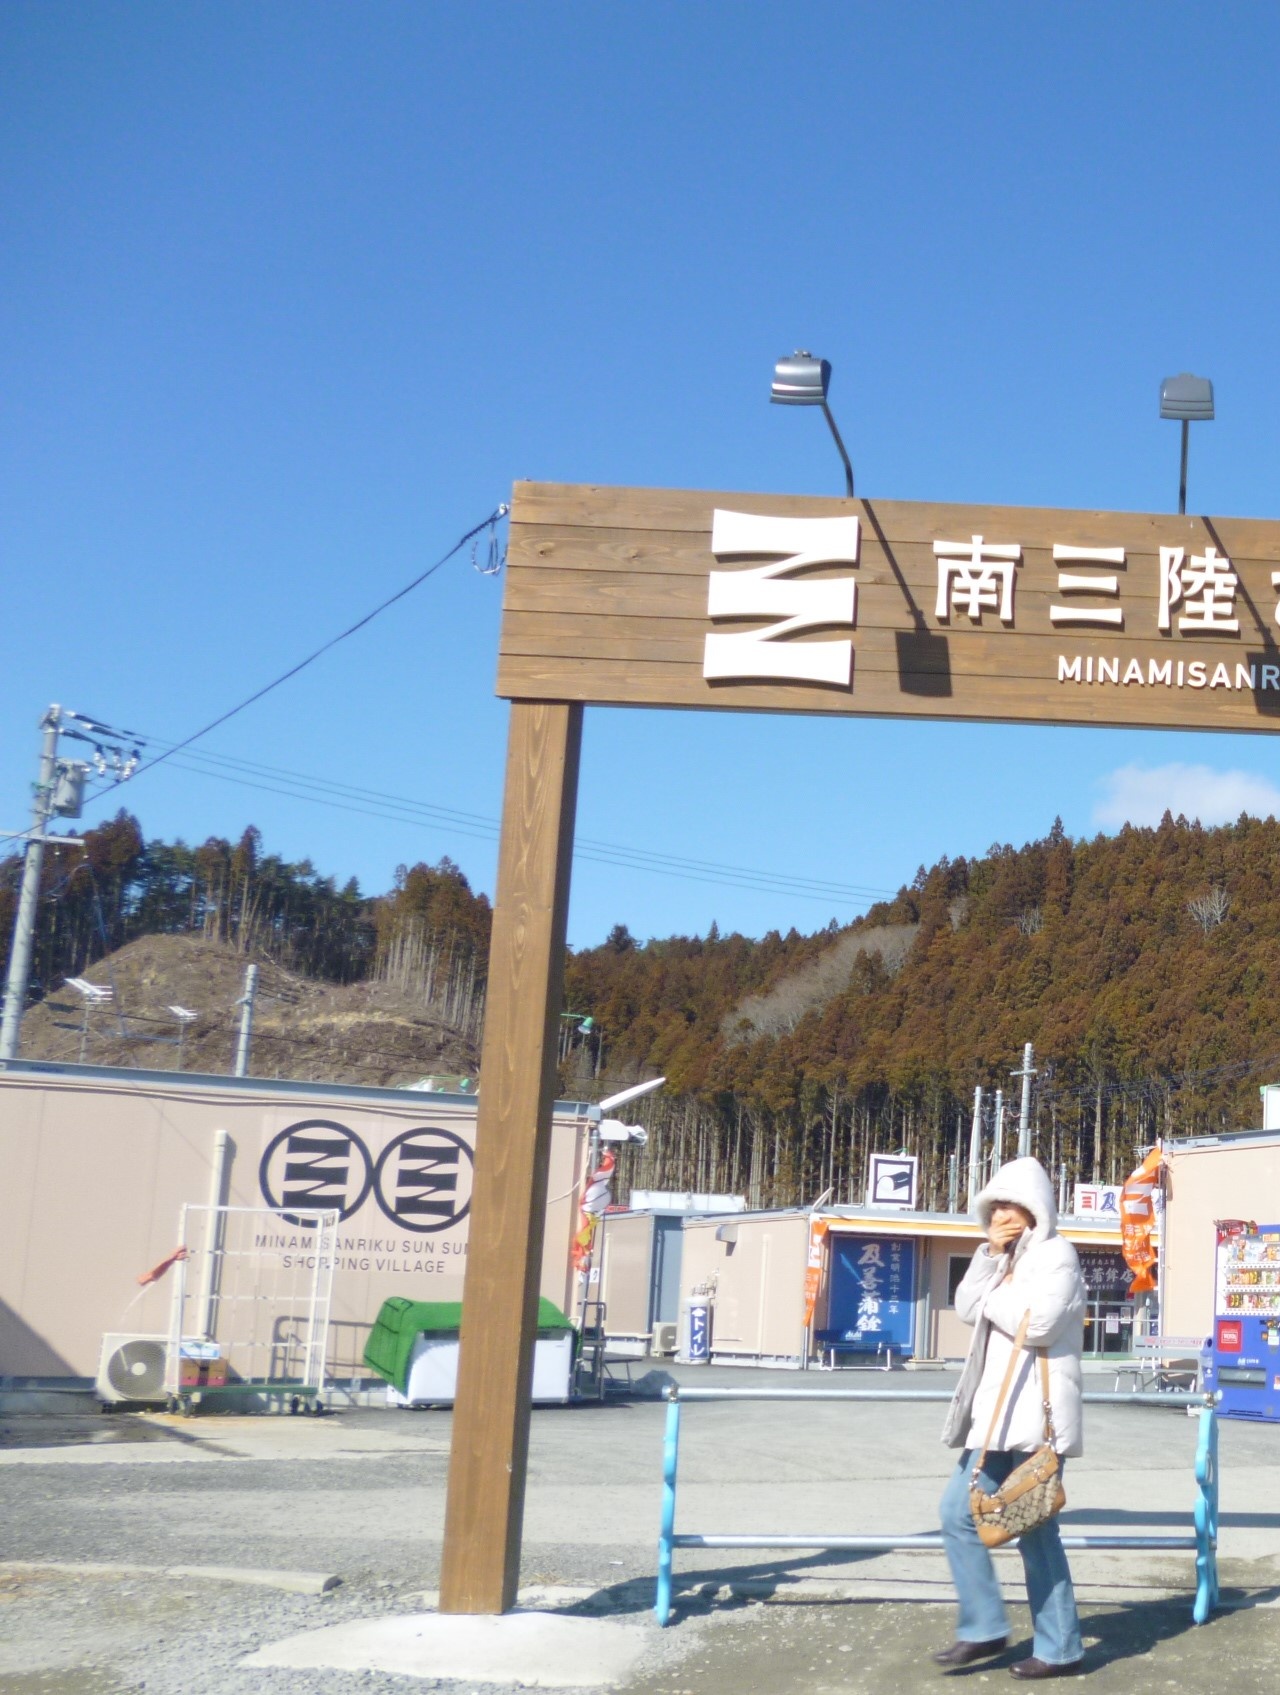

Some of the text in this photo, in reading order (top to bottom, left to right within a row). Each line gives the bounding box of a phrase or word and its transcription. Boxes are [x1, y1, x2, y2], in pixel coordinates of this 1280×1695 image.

[255, 1234, 397, 1253] MINAMSANRIKU
[402, 1240, 435, 1254] SUN
[375, 1259, 446, 1274] VILLAGE
[691, 1319, 706, 1355] トイレ
